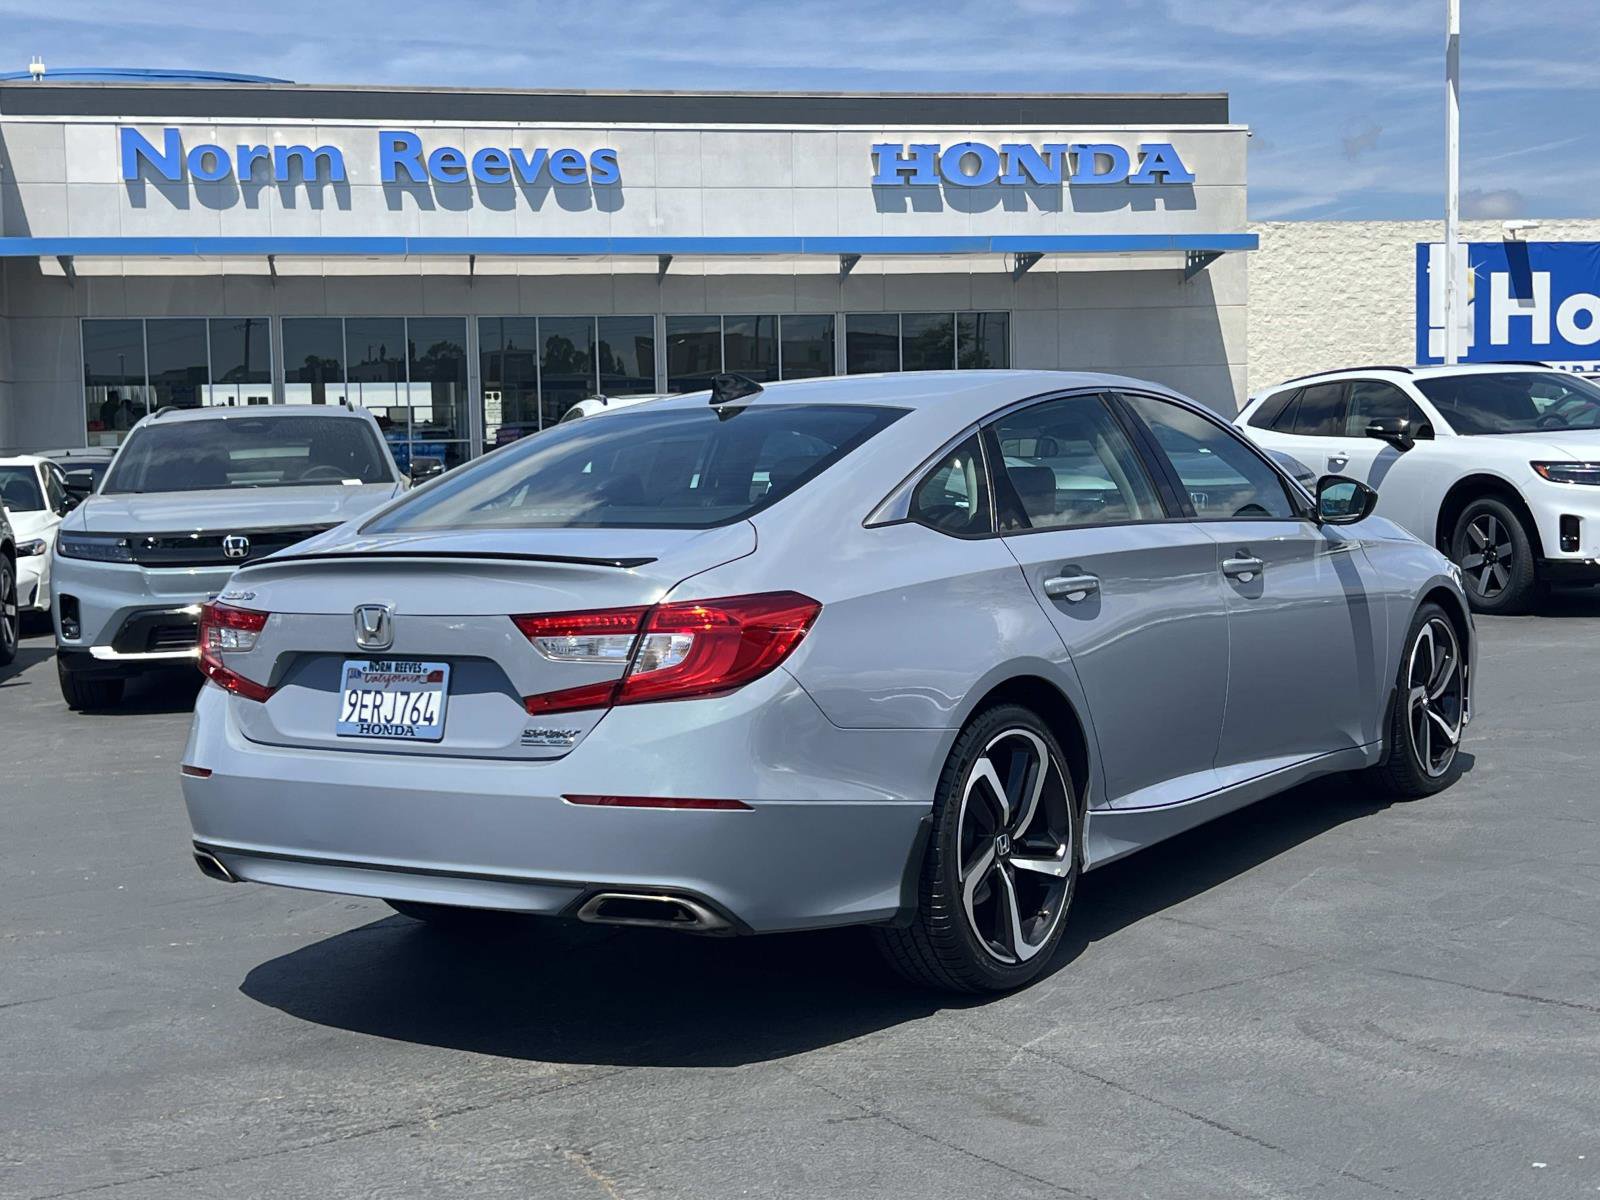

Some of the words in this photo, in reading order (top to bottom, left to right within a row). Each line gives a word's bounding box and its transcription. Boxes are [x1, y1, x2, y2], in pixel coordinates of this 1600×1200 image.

[120, 128, 346, 182] Norm
[379, 130, 620, 185] Reeves
[871, 142, 1195, 187] HONDA
[1490, 272, 1600, 346] Ho
[369, 661, 392, 673] NORM
[395, 662, 422, 673] REEVES
[345, 689, 434, 726] 9ERJ764
[359, 724, 416, 736] HONDA
